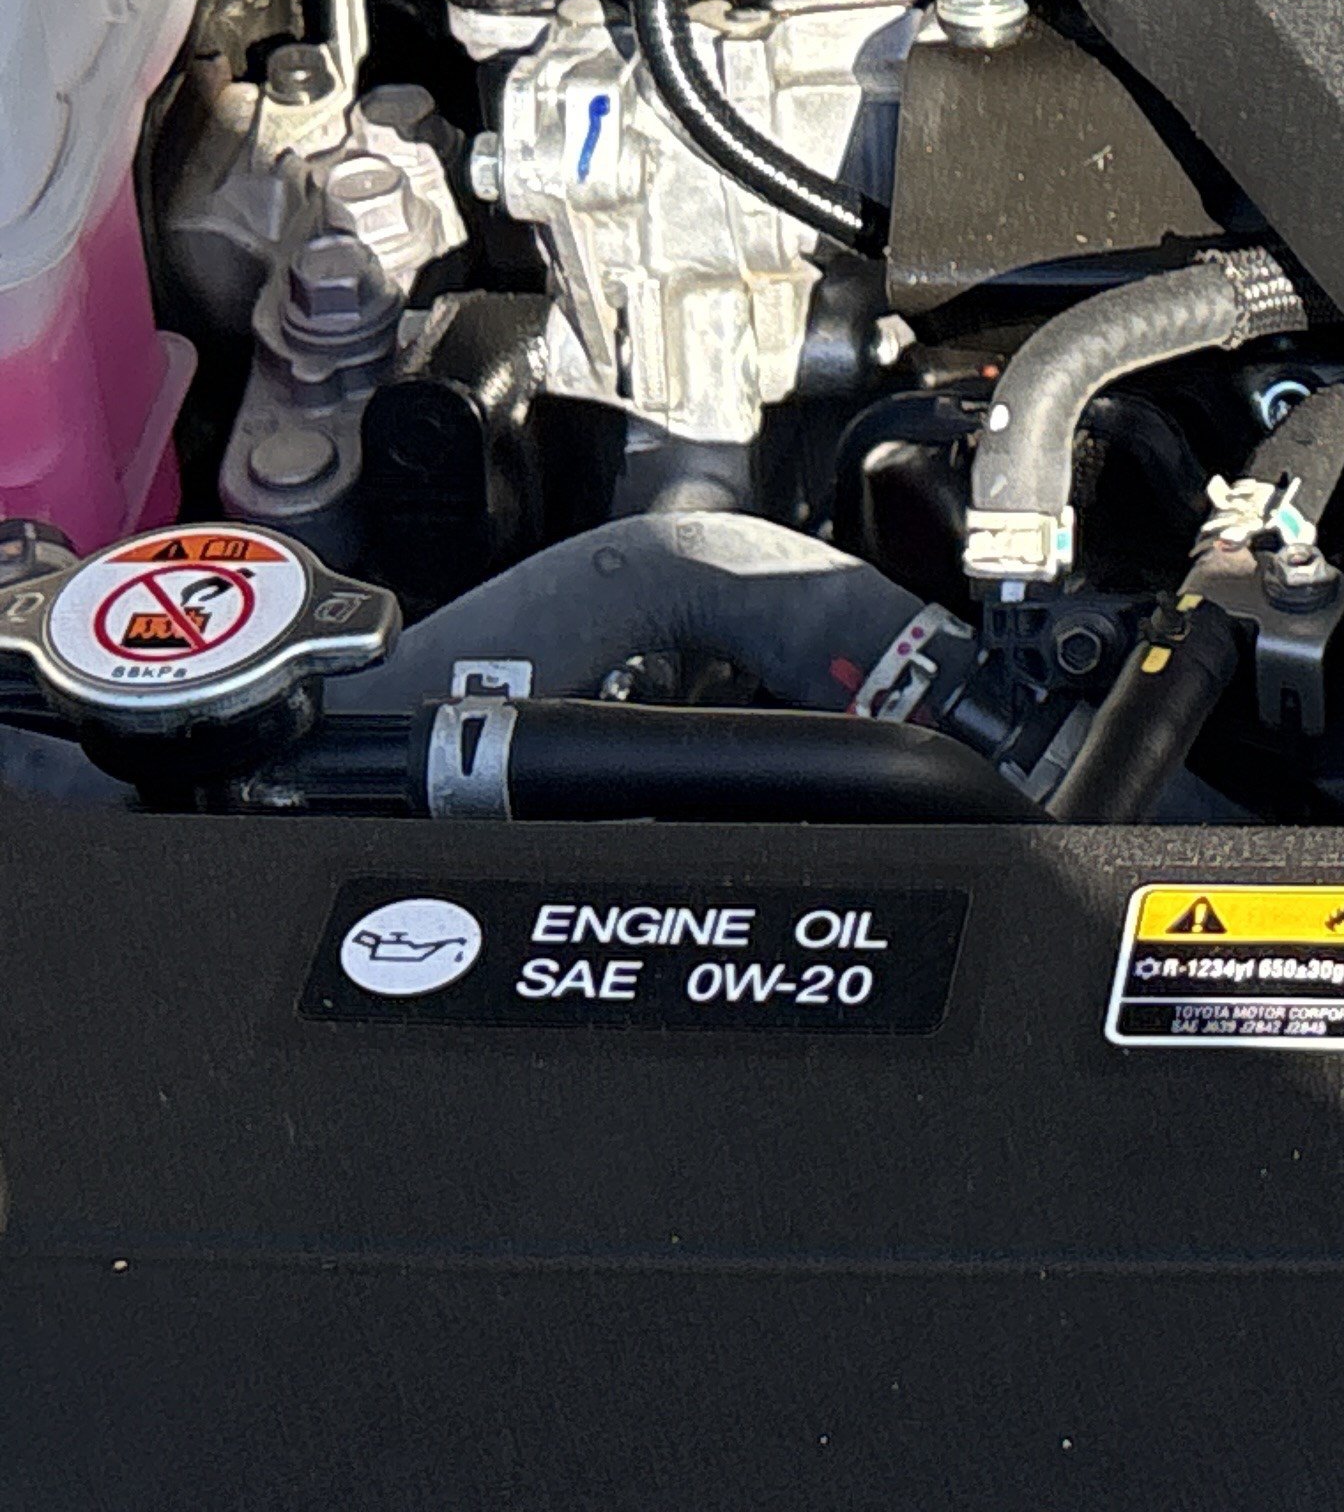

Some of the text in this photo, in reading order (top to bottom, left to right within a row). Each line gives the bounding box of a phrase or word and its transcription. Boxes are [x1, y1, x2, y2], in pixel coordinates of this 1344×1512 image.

[530, 905, 888, 950] ENGINE OIL
[515, 958, 873, 1004] SAE 0W-20
[1171, 1020, 1198, 1033] SAE
[1175, 1006, 1229, 1020] TOYOTA
[1232, 1006, 1286, 1021] MOTOR
